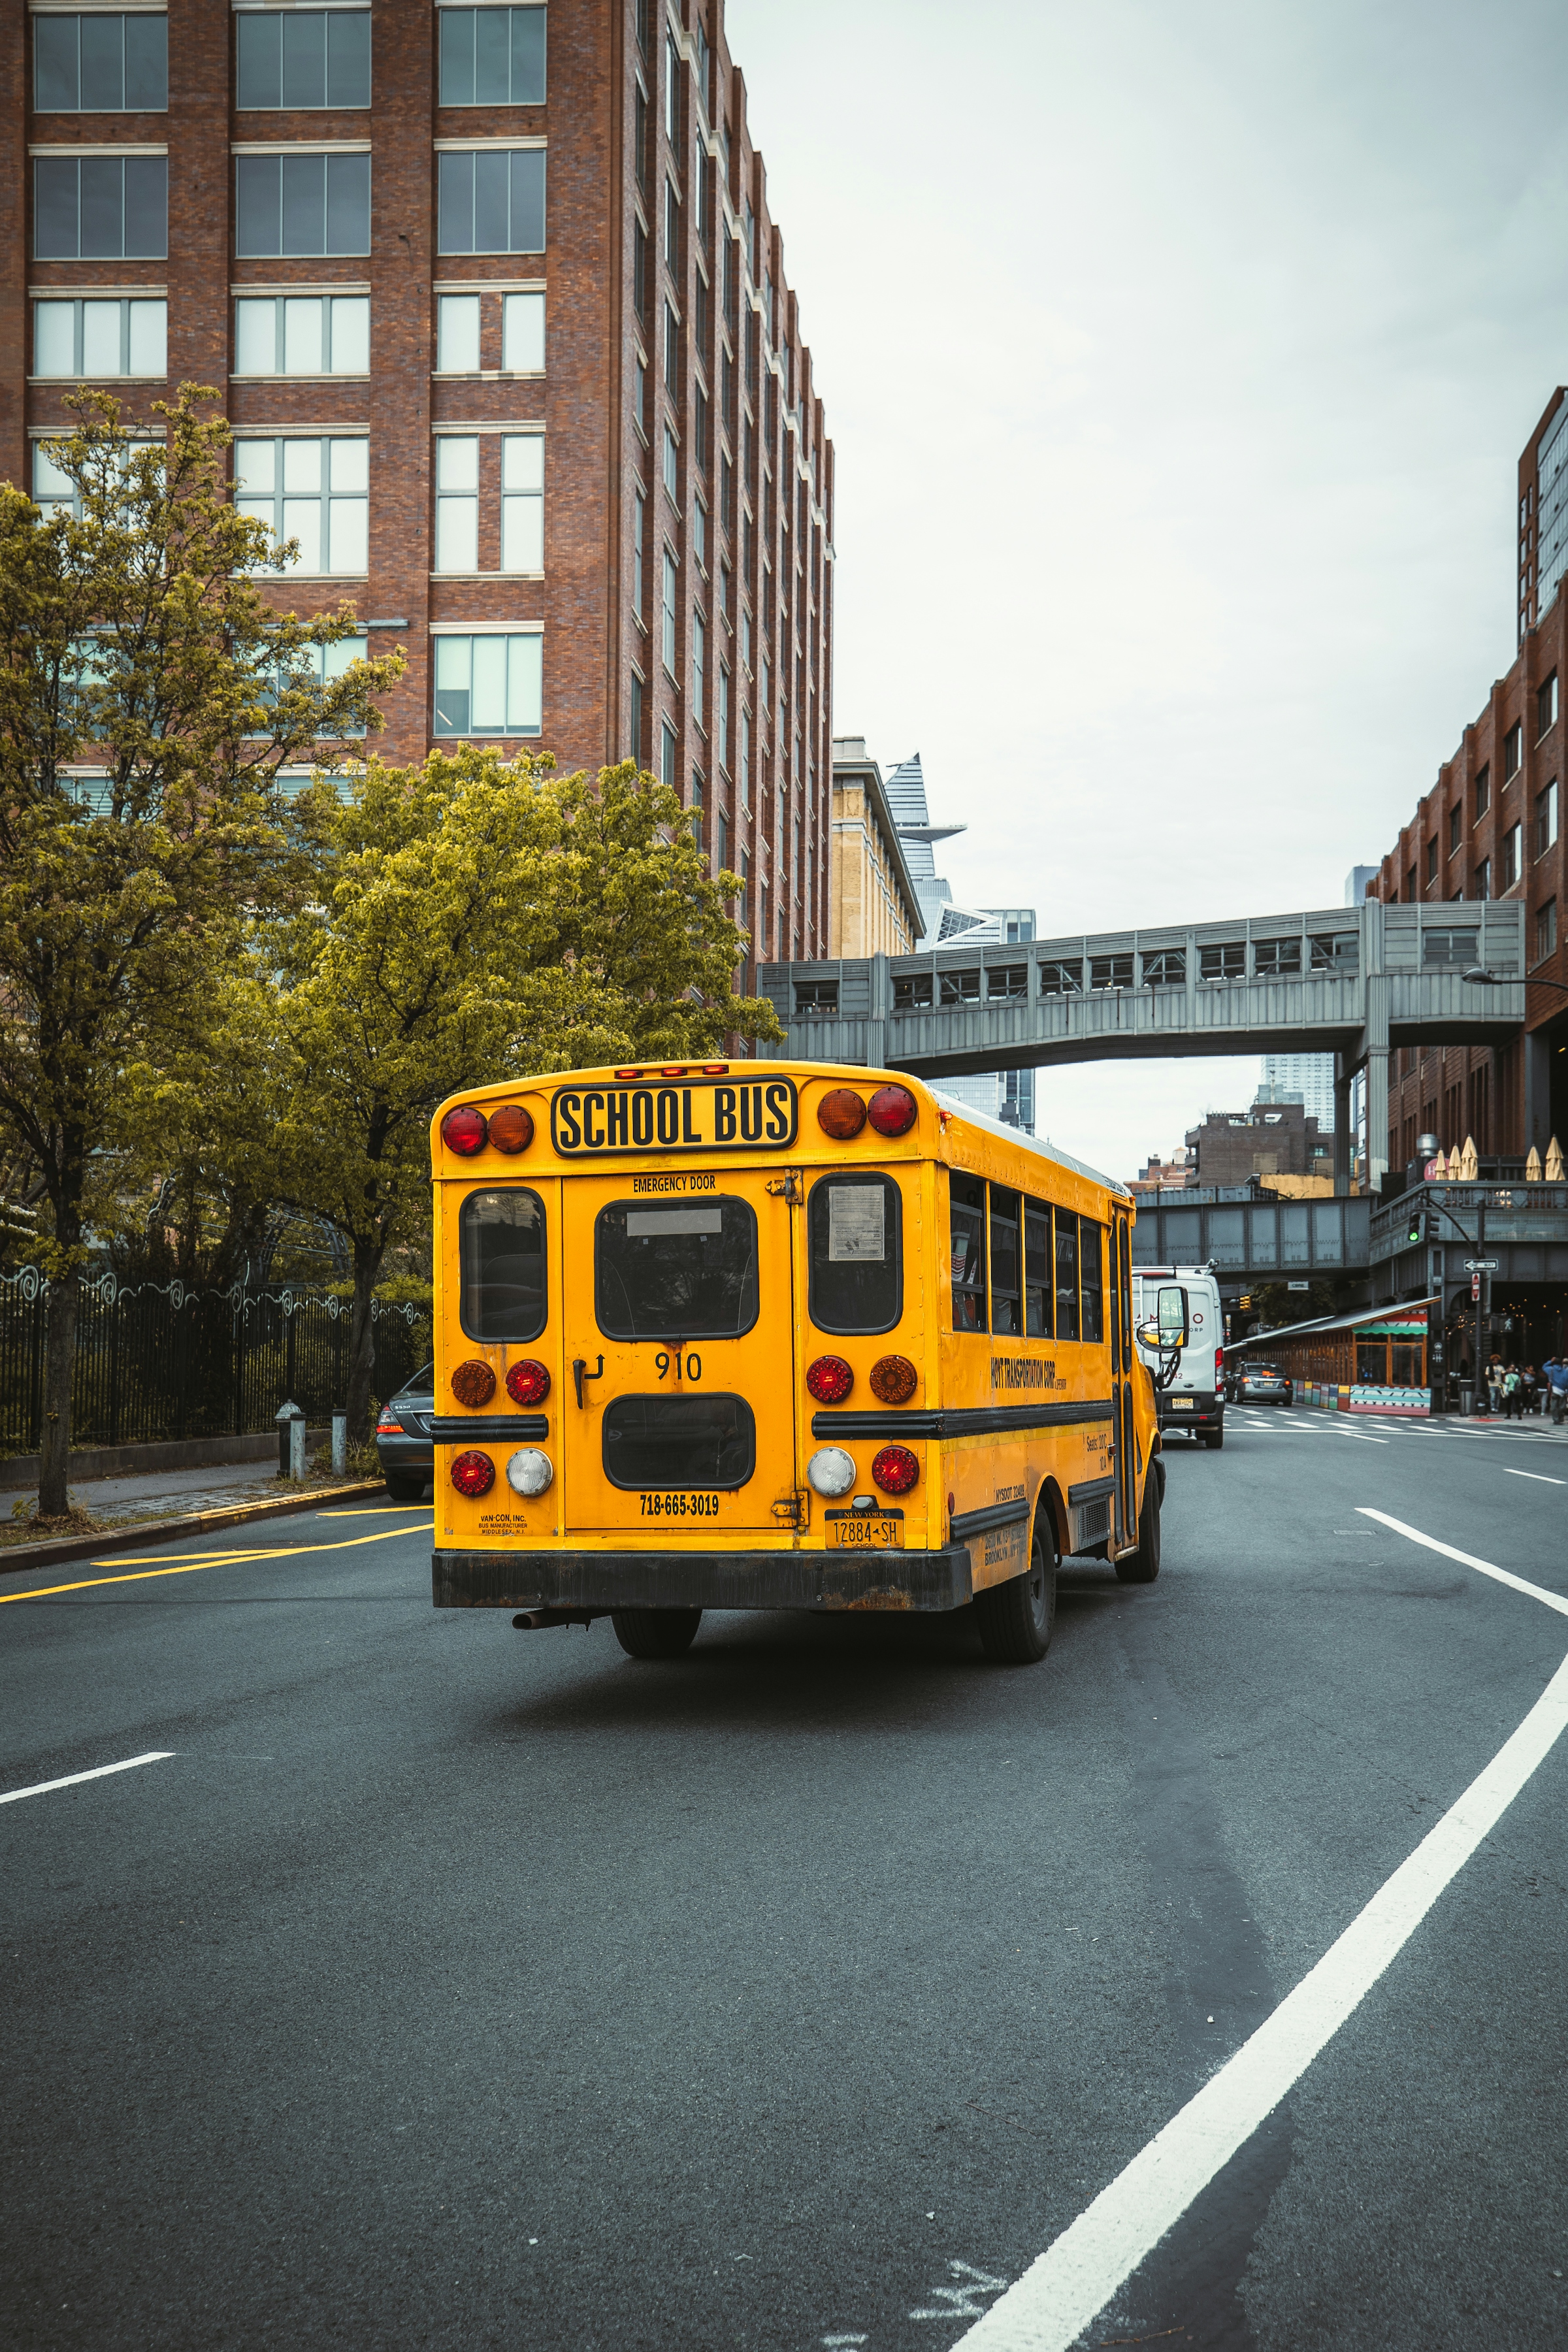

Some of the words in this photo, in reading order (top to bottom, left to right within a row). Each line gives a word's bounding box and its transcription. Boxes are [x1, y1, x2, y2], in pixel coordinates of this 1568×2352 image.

[560, 1089, 702, 1149] SCHOOL
[714, 1084, 788, 1142] BUS
[633, 1177, 687, 1193] EMERGENCY
[690, 1175, 716, 1190] DOOR
[655, 1352, 702, 1381] 910
[990, 1357, 1004, 1389] HOYT
[1004, 1358, 1043, 1389] TRANSPORTATION
[640, 1494, 719, 1516] 718-665-3019
[996, 1486, 1012, 1503] NYSDOT
[480, 1514, 512, 1523] VAN-CON,
